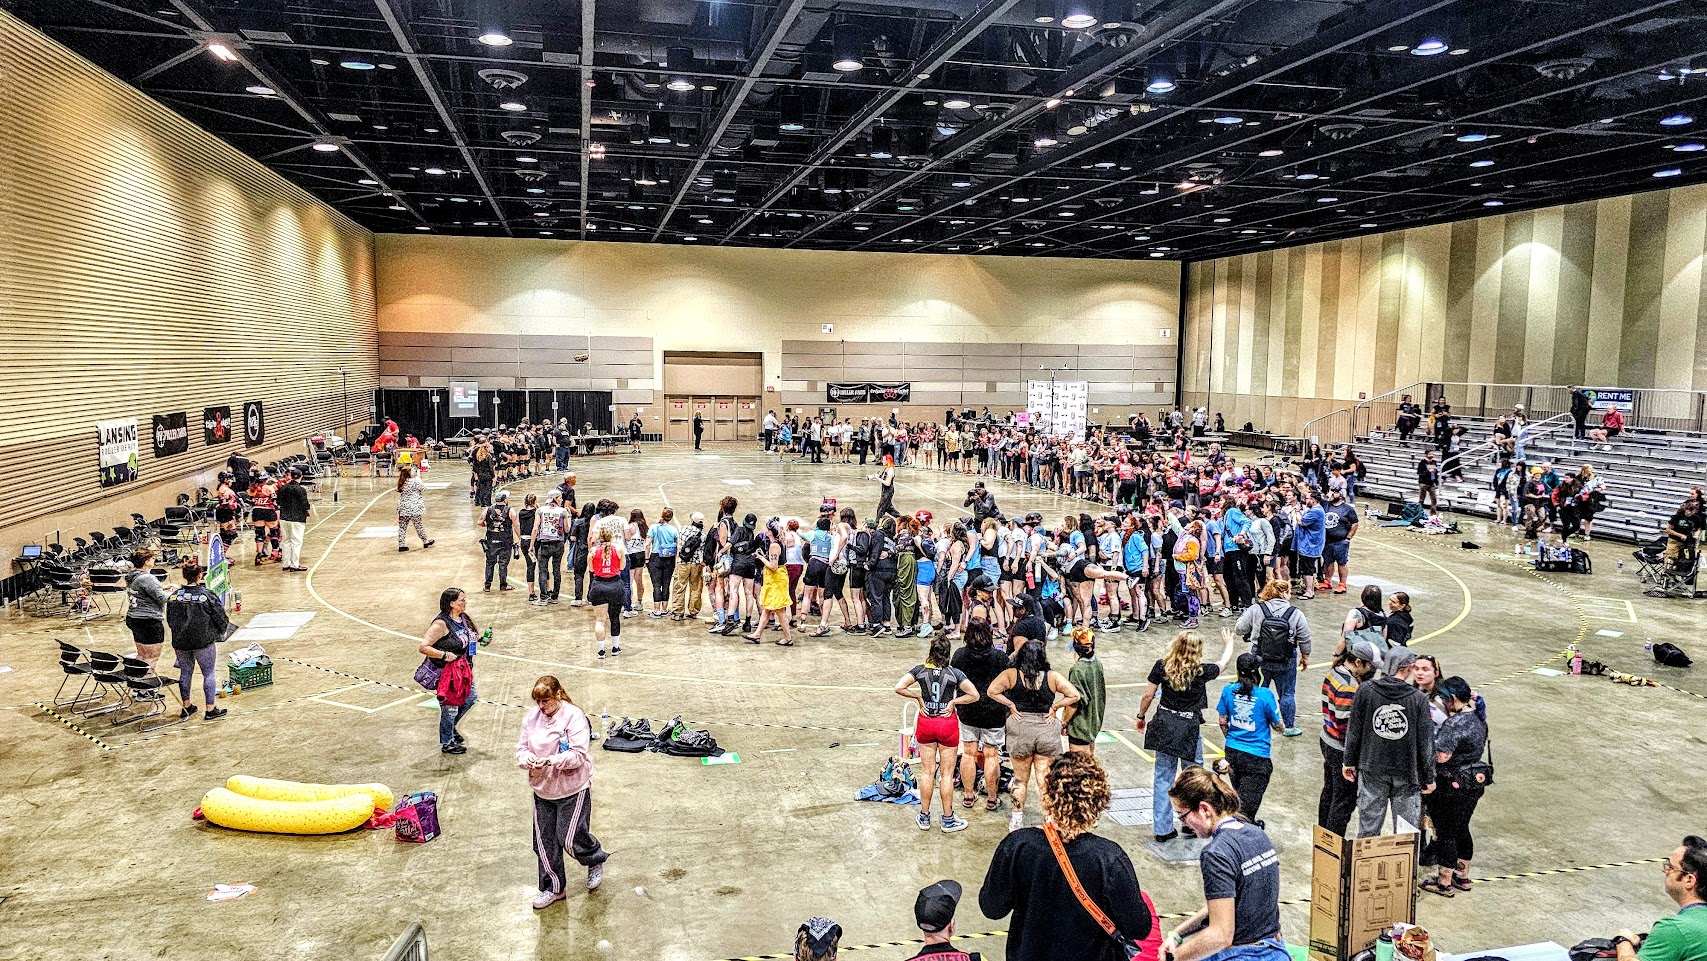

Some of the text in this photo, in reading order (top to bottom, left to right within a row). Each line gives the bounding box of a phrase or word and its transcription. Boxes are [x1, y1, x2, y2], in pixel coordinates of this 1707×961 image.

[1598, 392, 1631, 401] RENT ME
[98, 424, 136, 446] LANSING
[101, 443, 136, 455] ROLLER DERBY
[932, 682, 940, 702] 9
